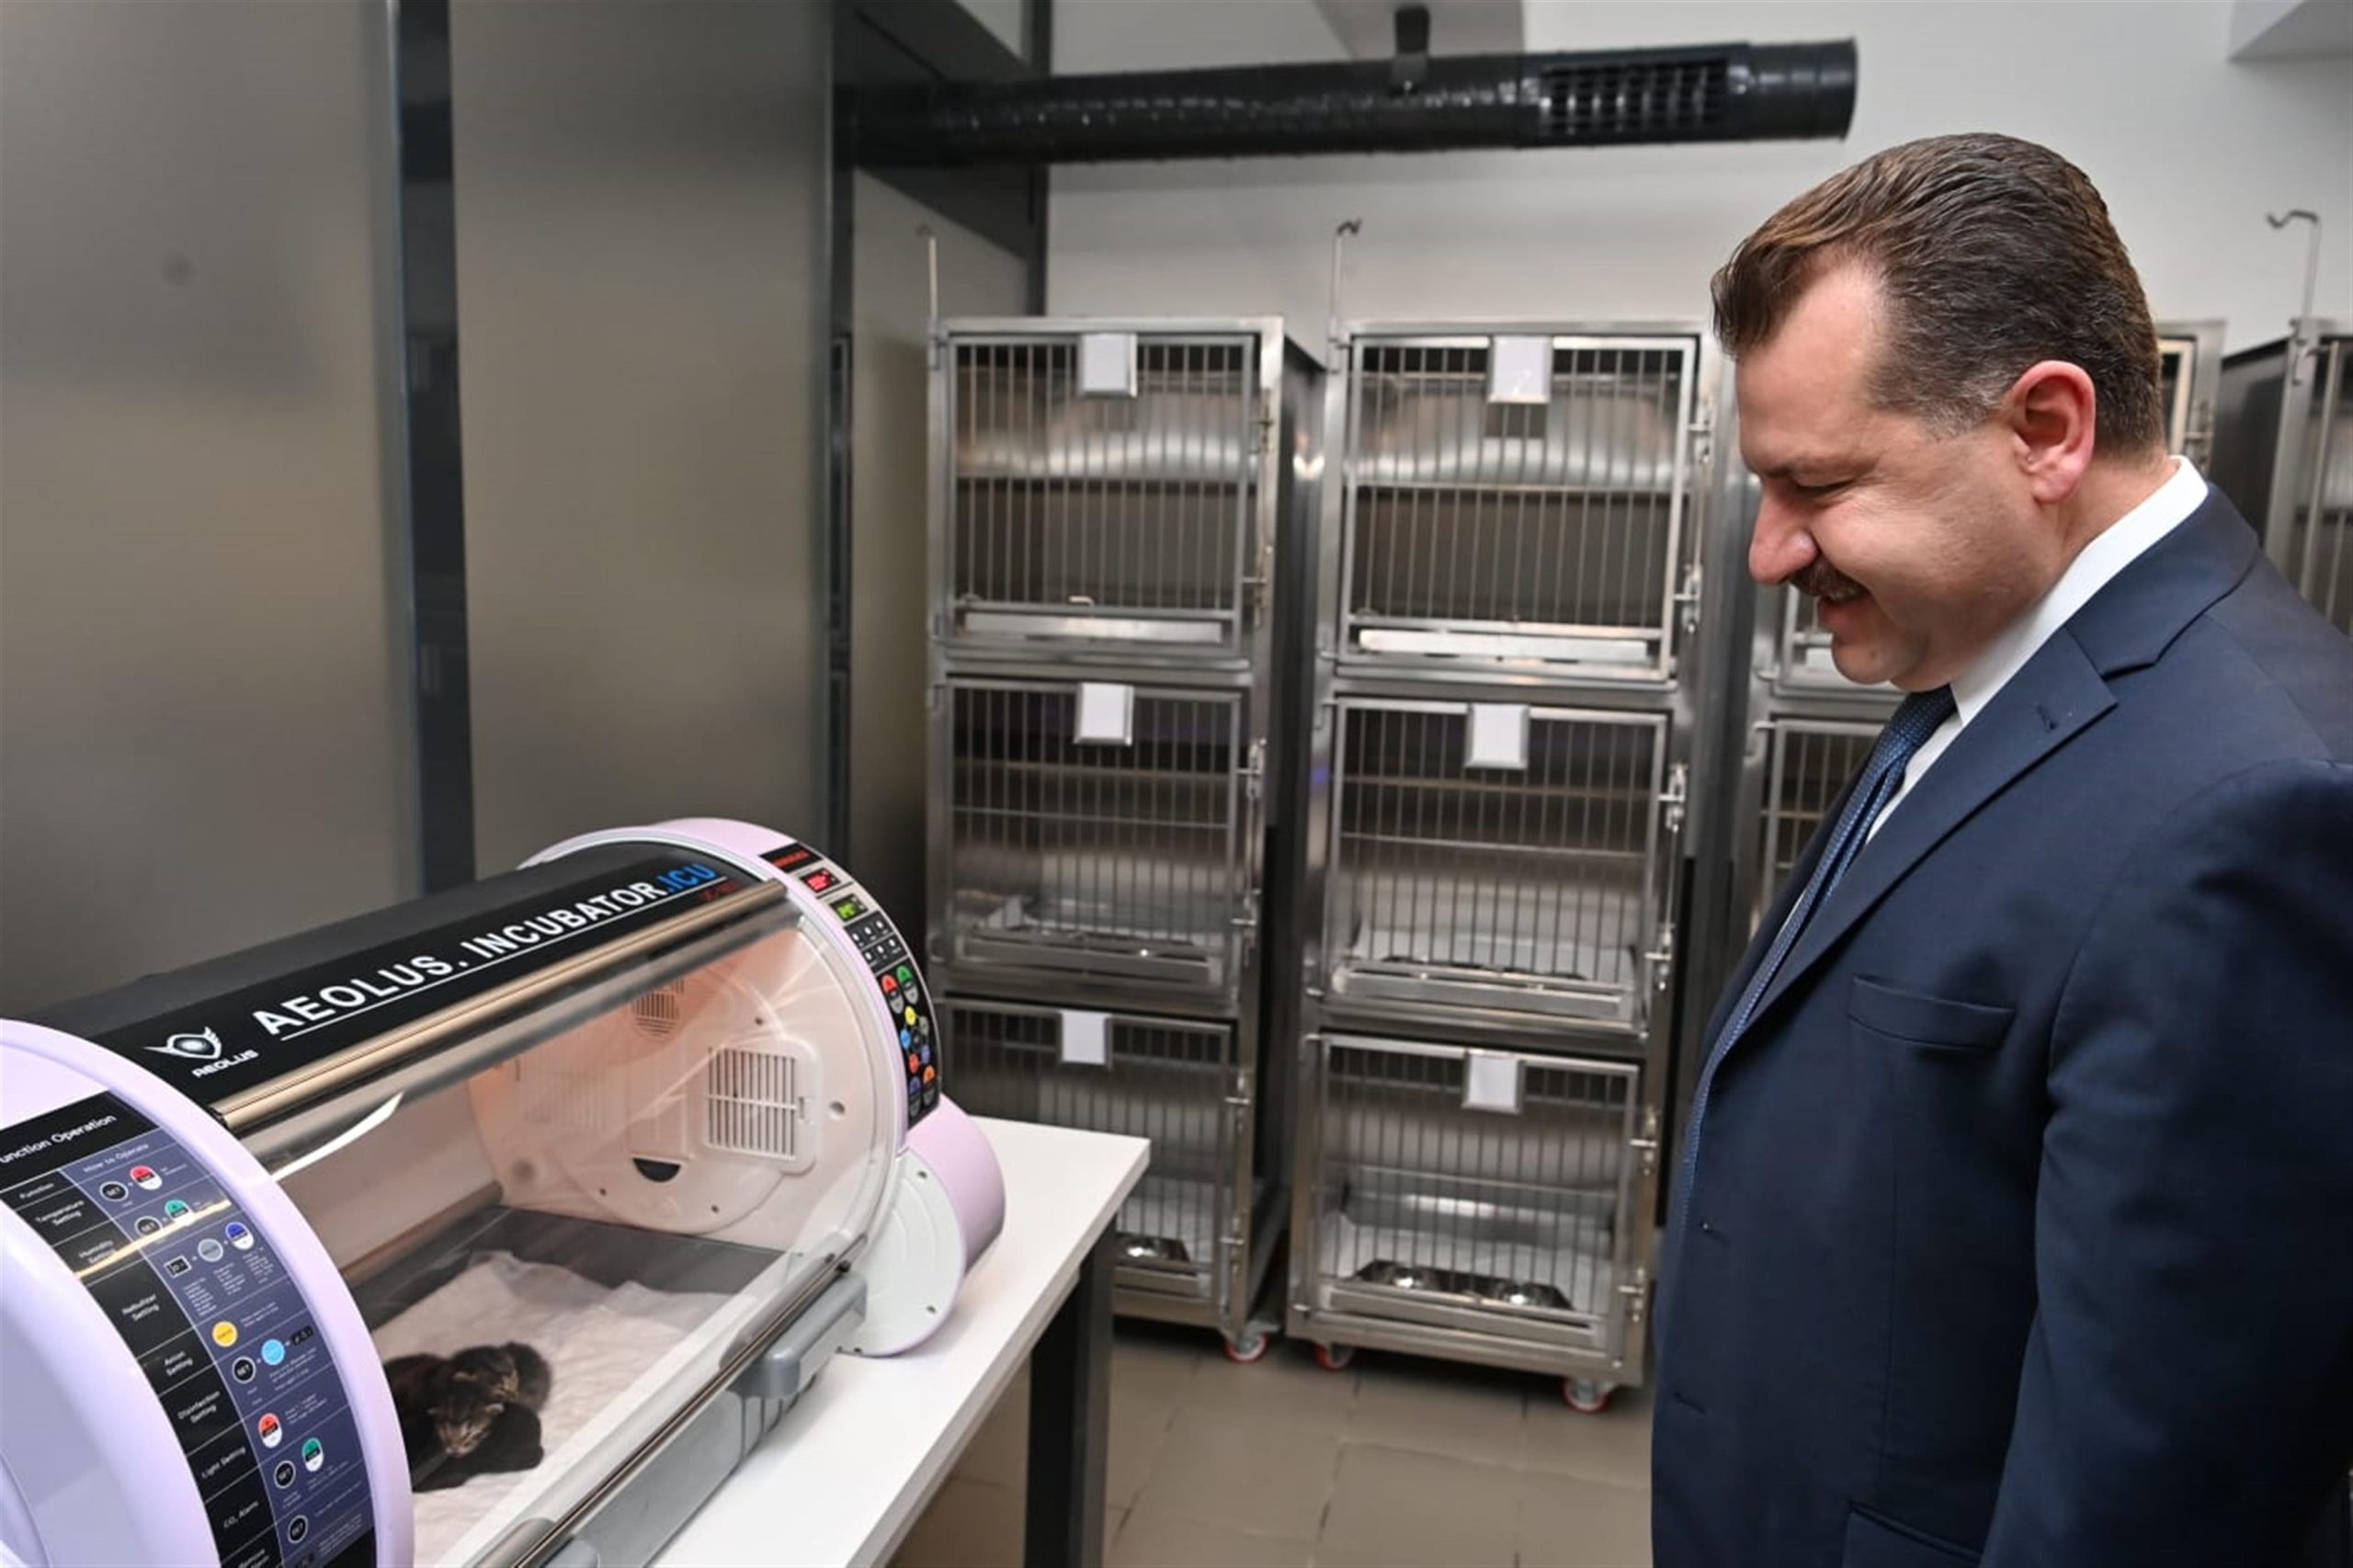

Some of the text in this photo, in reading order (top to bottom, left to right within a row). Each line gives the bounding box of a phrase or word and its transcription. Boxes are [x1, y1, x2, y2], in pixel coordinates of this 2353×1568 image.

[191, 1049, 259, 1078] AEOLUS
[0, 1115, 118, 1164] unction Operation
